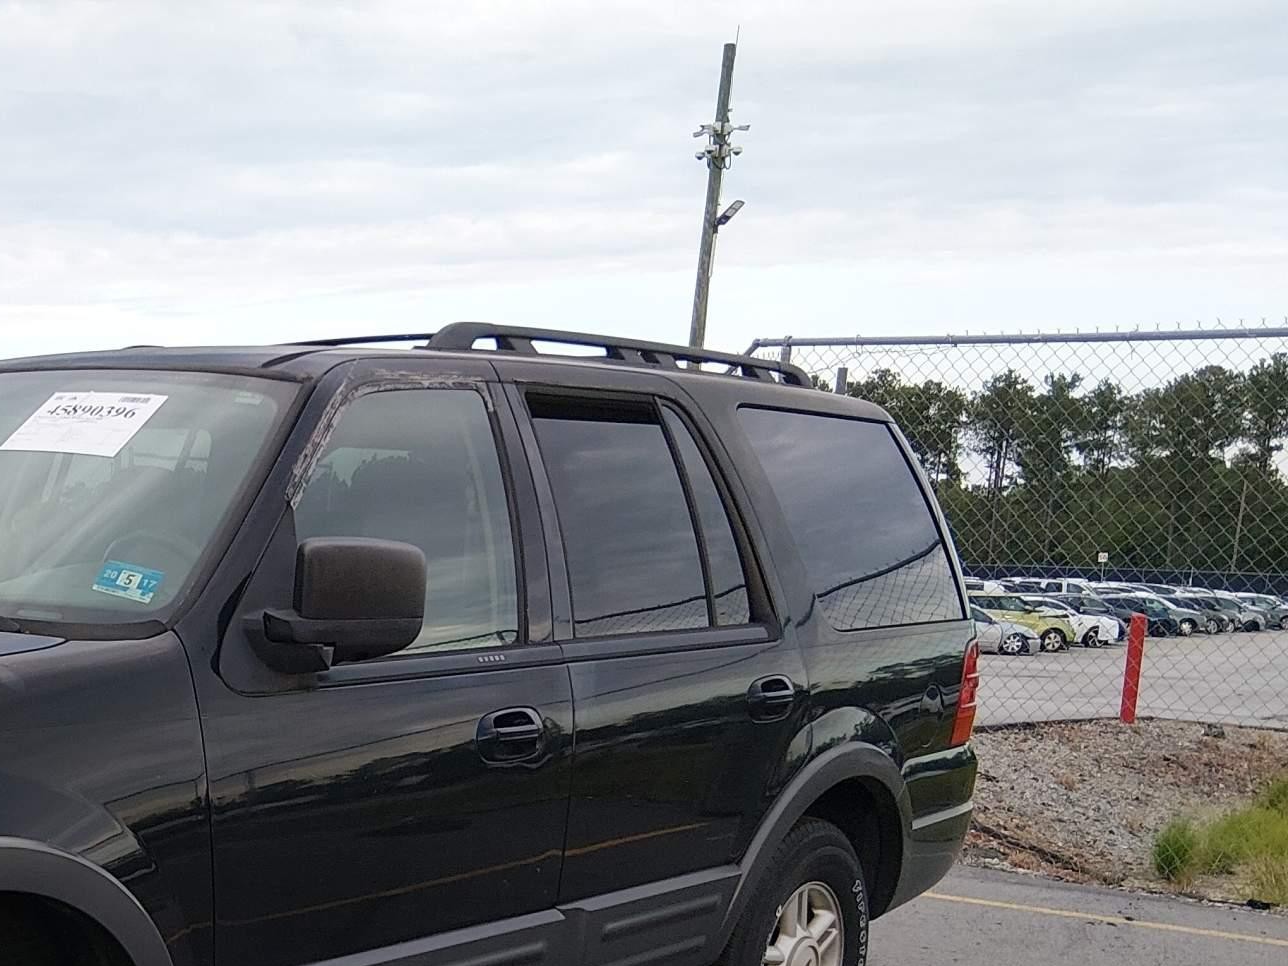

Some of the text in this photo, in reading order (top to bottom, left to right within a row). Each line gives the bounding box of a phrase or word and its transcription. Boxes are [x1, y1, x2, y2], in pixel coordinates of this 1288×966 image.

[47, 403, 140, 420] 45890396
[103, 569, 158, 589] 20 5 17
